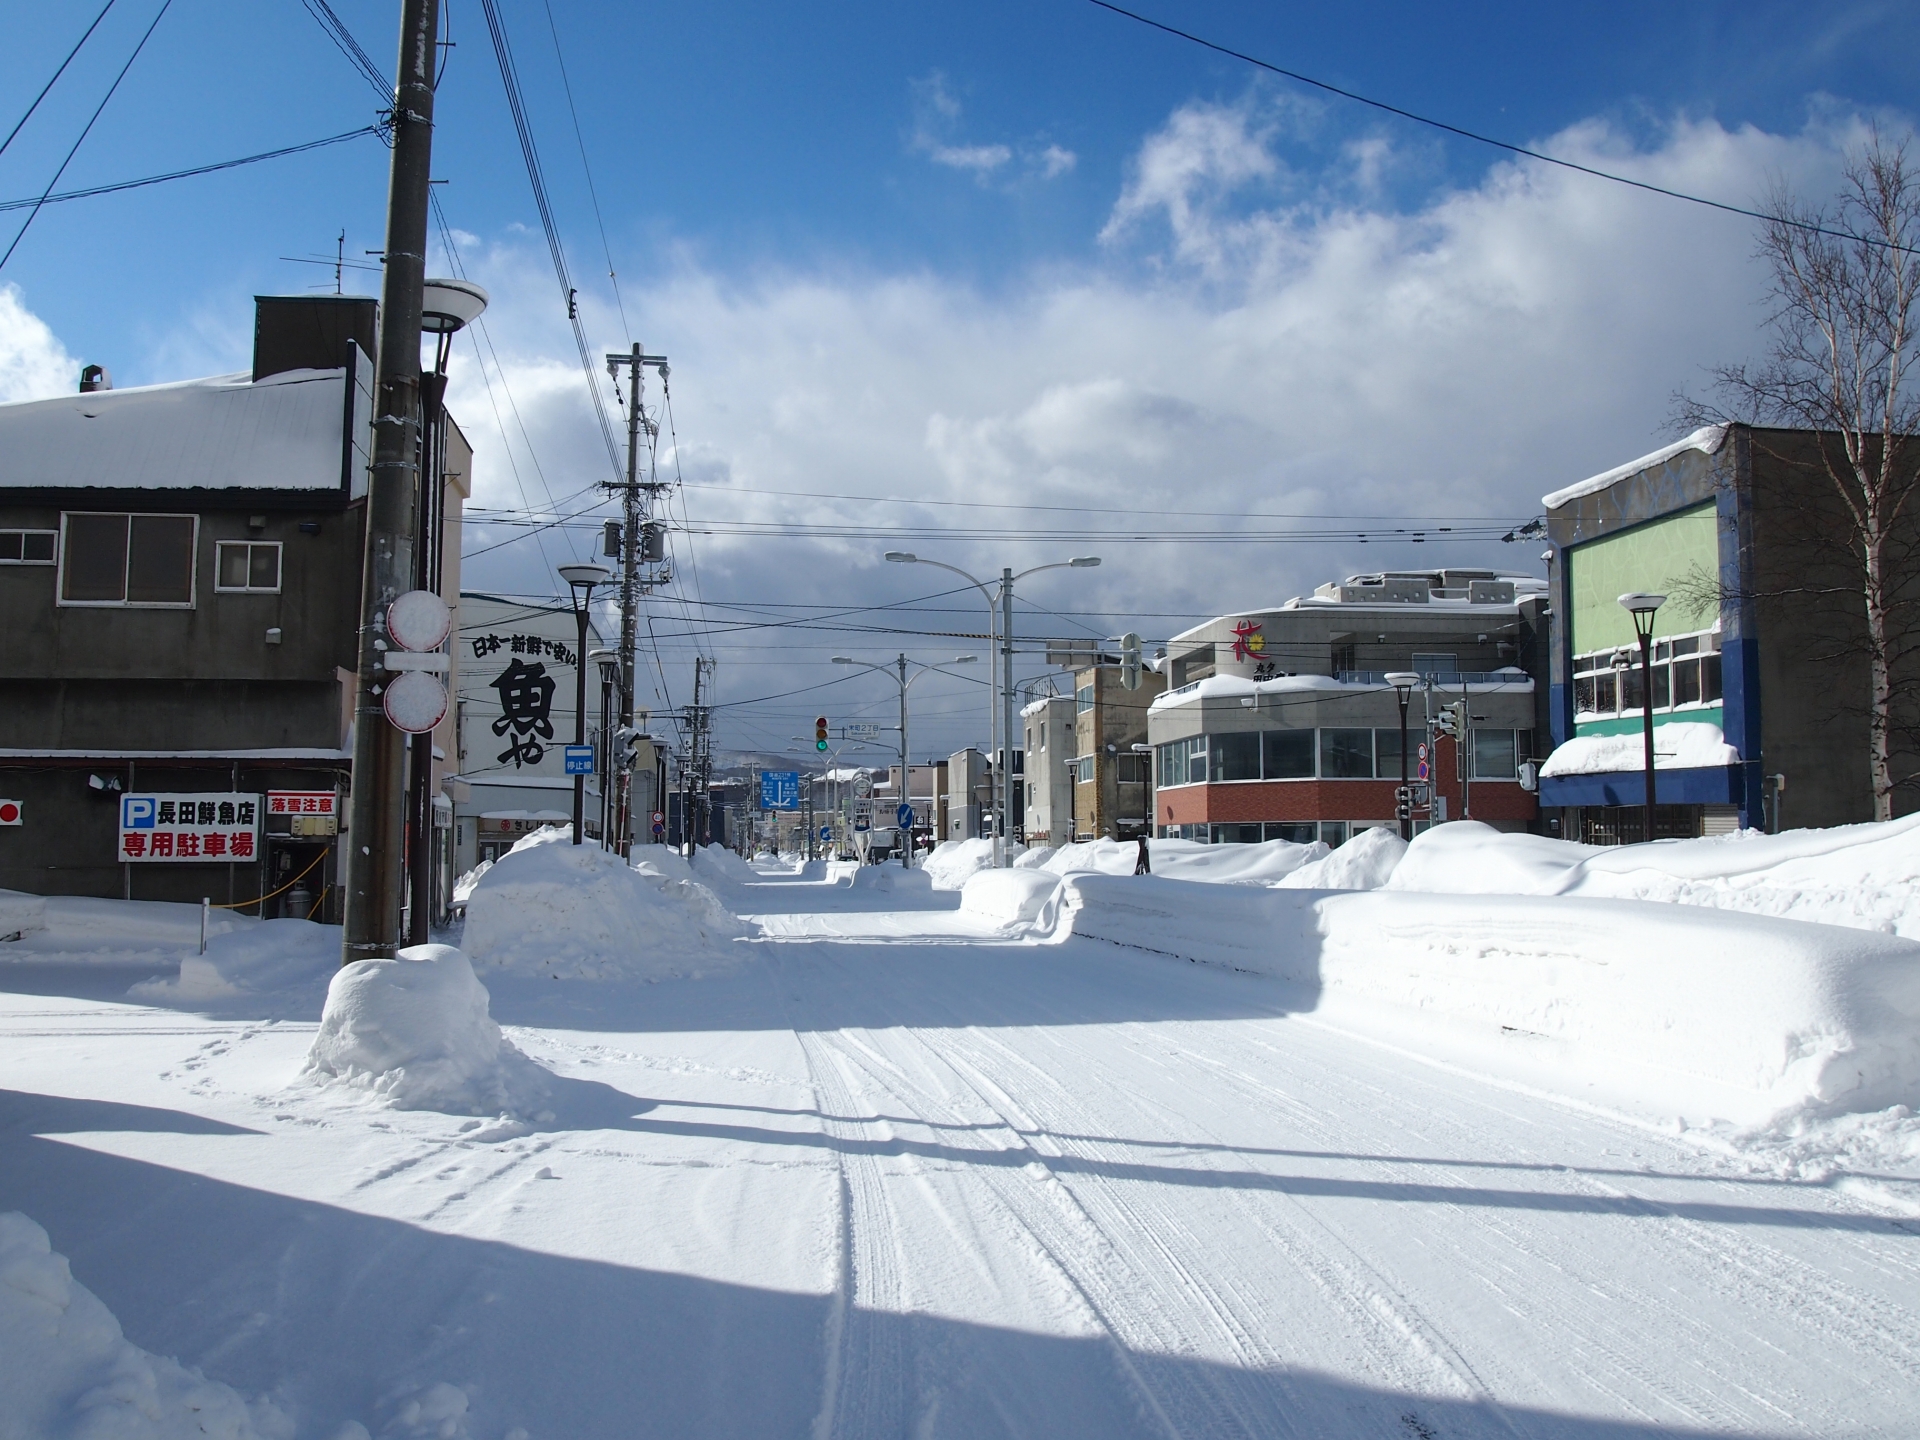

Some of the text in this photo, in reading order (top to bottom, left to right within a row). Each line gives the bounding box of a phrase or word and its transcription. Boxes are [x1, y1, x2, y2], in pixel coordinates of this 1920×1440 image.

[1229, 620, 1270, 661] 花
[567, 760, 592, 770] 停止線
[127, 800, 255, 827] P 長田鮮魚店
[271, 798, 333, 812] 落雪注意
[122, 832, 255, 857] 専用駐車場
